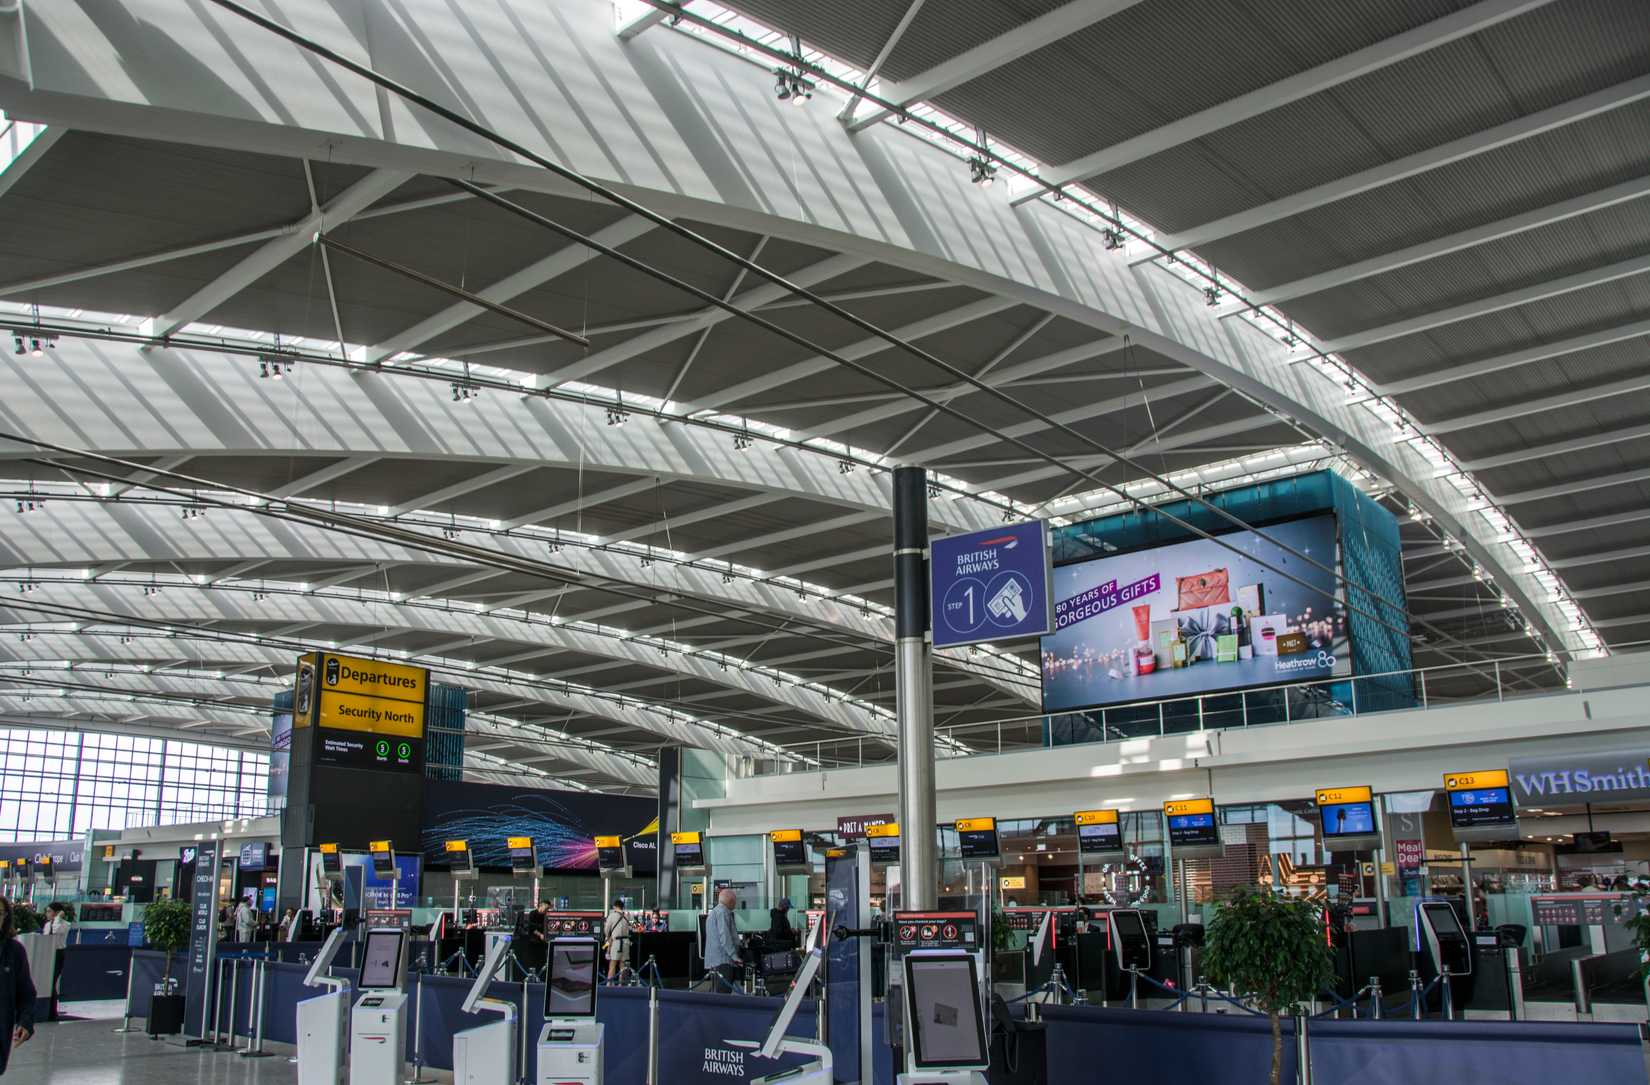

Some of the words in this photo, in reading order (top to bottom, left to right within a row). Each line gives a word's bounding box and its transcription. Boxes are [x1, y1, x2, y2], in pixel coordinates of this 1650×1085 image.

[957, 548, 997, 565] BRITISH
[955, 560, 999, 576] AIRWAYS
[1121, 577, 1156, 600] GIFTS
[947, 602, 962, 610] STEP
[964, 586, 974, 625] 1
[1056, 602, 1068, 613] 80
[1069, 590, 1099, 606] YEARS
[1101, 582, 1114, 594] OF
[1275, 658, 1317, 670] Heathrow
[341, 666, 417, 689] Departures
[338, 704, 382, 722] Security
[385, 711, 415, 724] North
[1459, 777, 1475, 785] C13
[1516, 765, 1650, 797] WHSmith
[843, 822, 857, 833] PRET
[858, 822, 863, 832] A
[633, 841, 649, 849] Cisco
[1398, 843, 1421, 852] Meal
[1399, 853, 1422, 863] Deal
[704, 1048, 743, 1064] BRITISH
[702, 1061, 744, 1077] AIRWAYS
